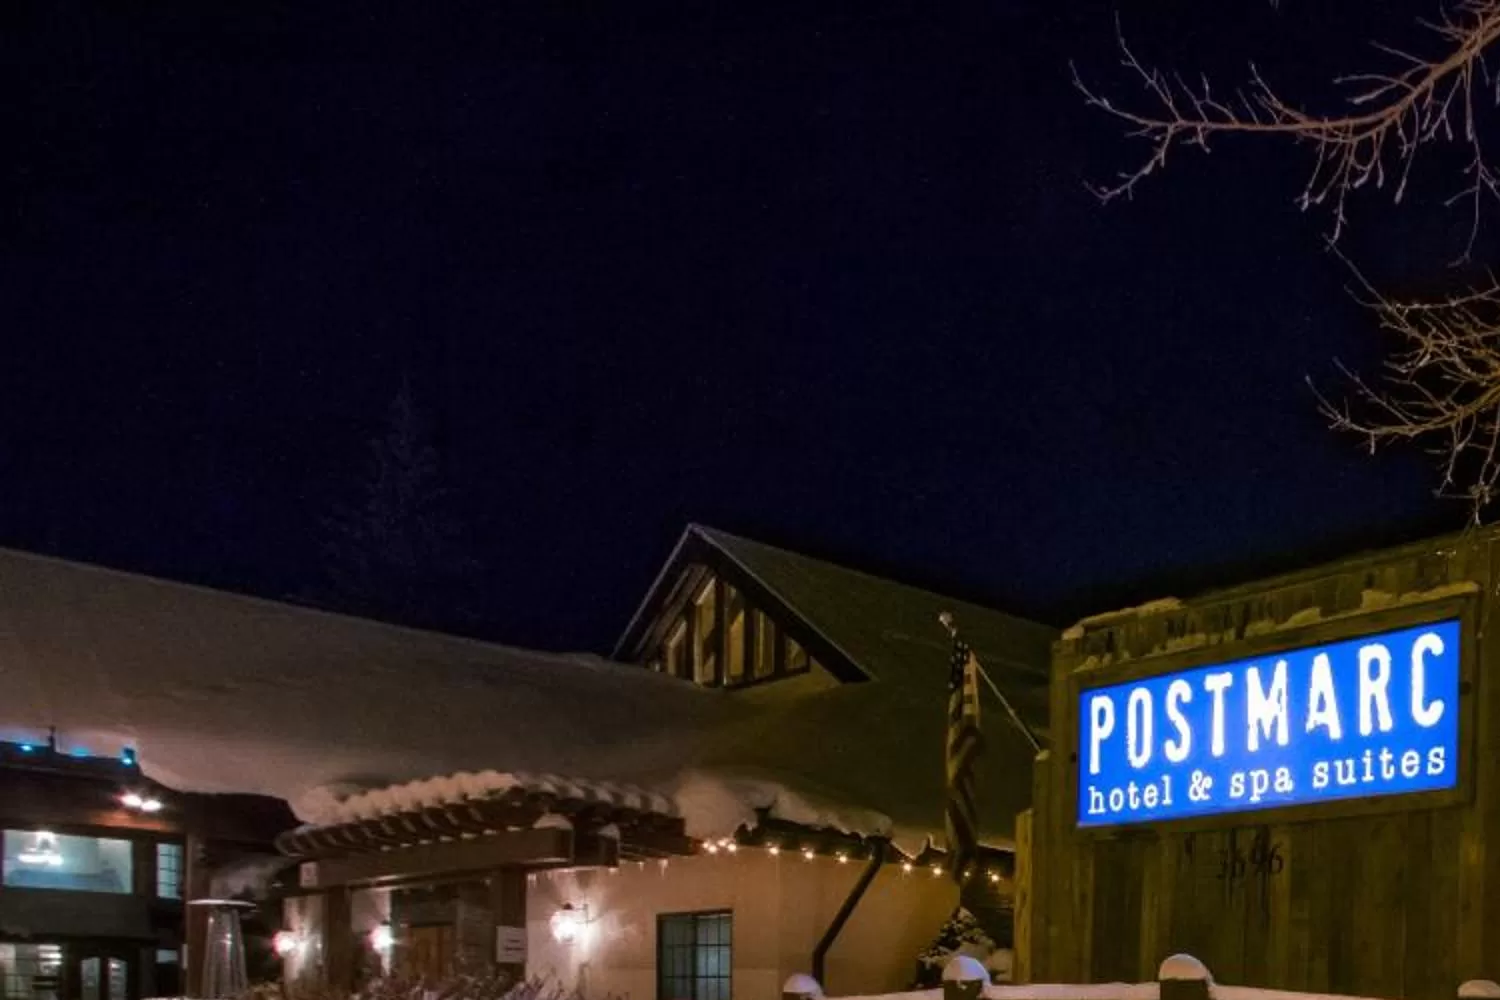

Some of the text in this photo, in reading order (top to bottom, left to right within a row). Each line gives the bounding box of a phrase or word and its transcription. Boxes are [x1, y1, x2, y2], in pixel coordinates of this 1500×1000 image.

[1089, 633, 1445, 774] POSTMARC
[1088, 745, 1446, 814] hotel & spa suites
